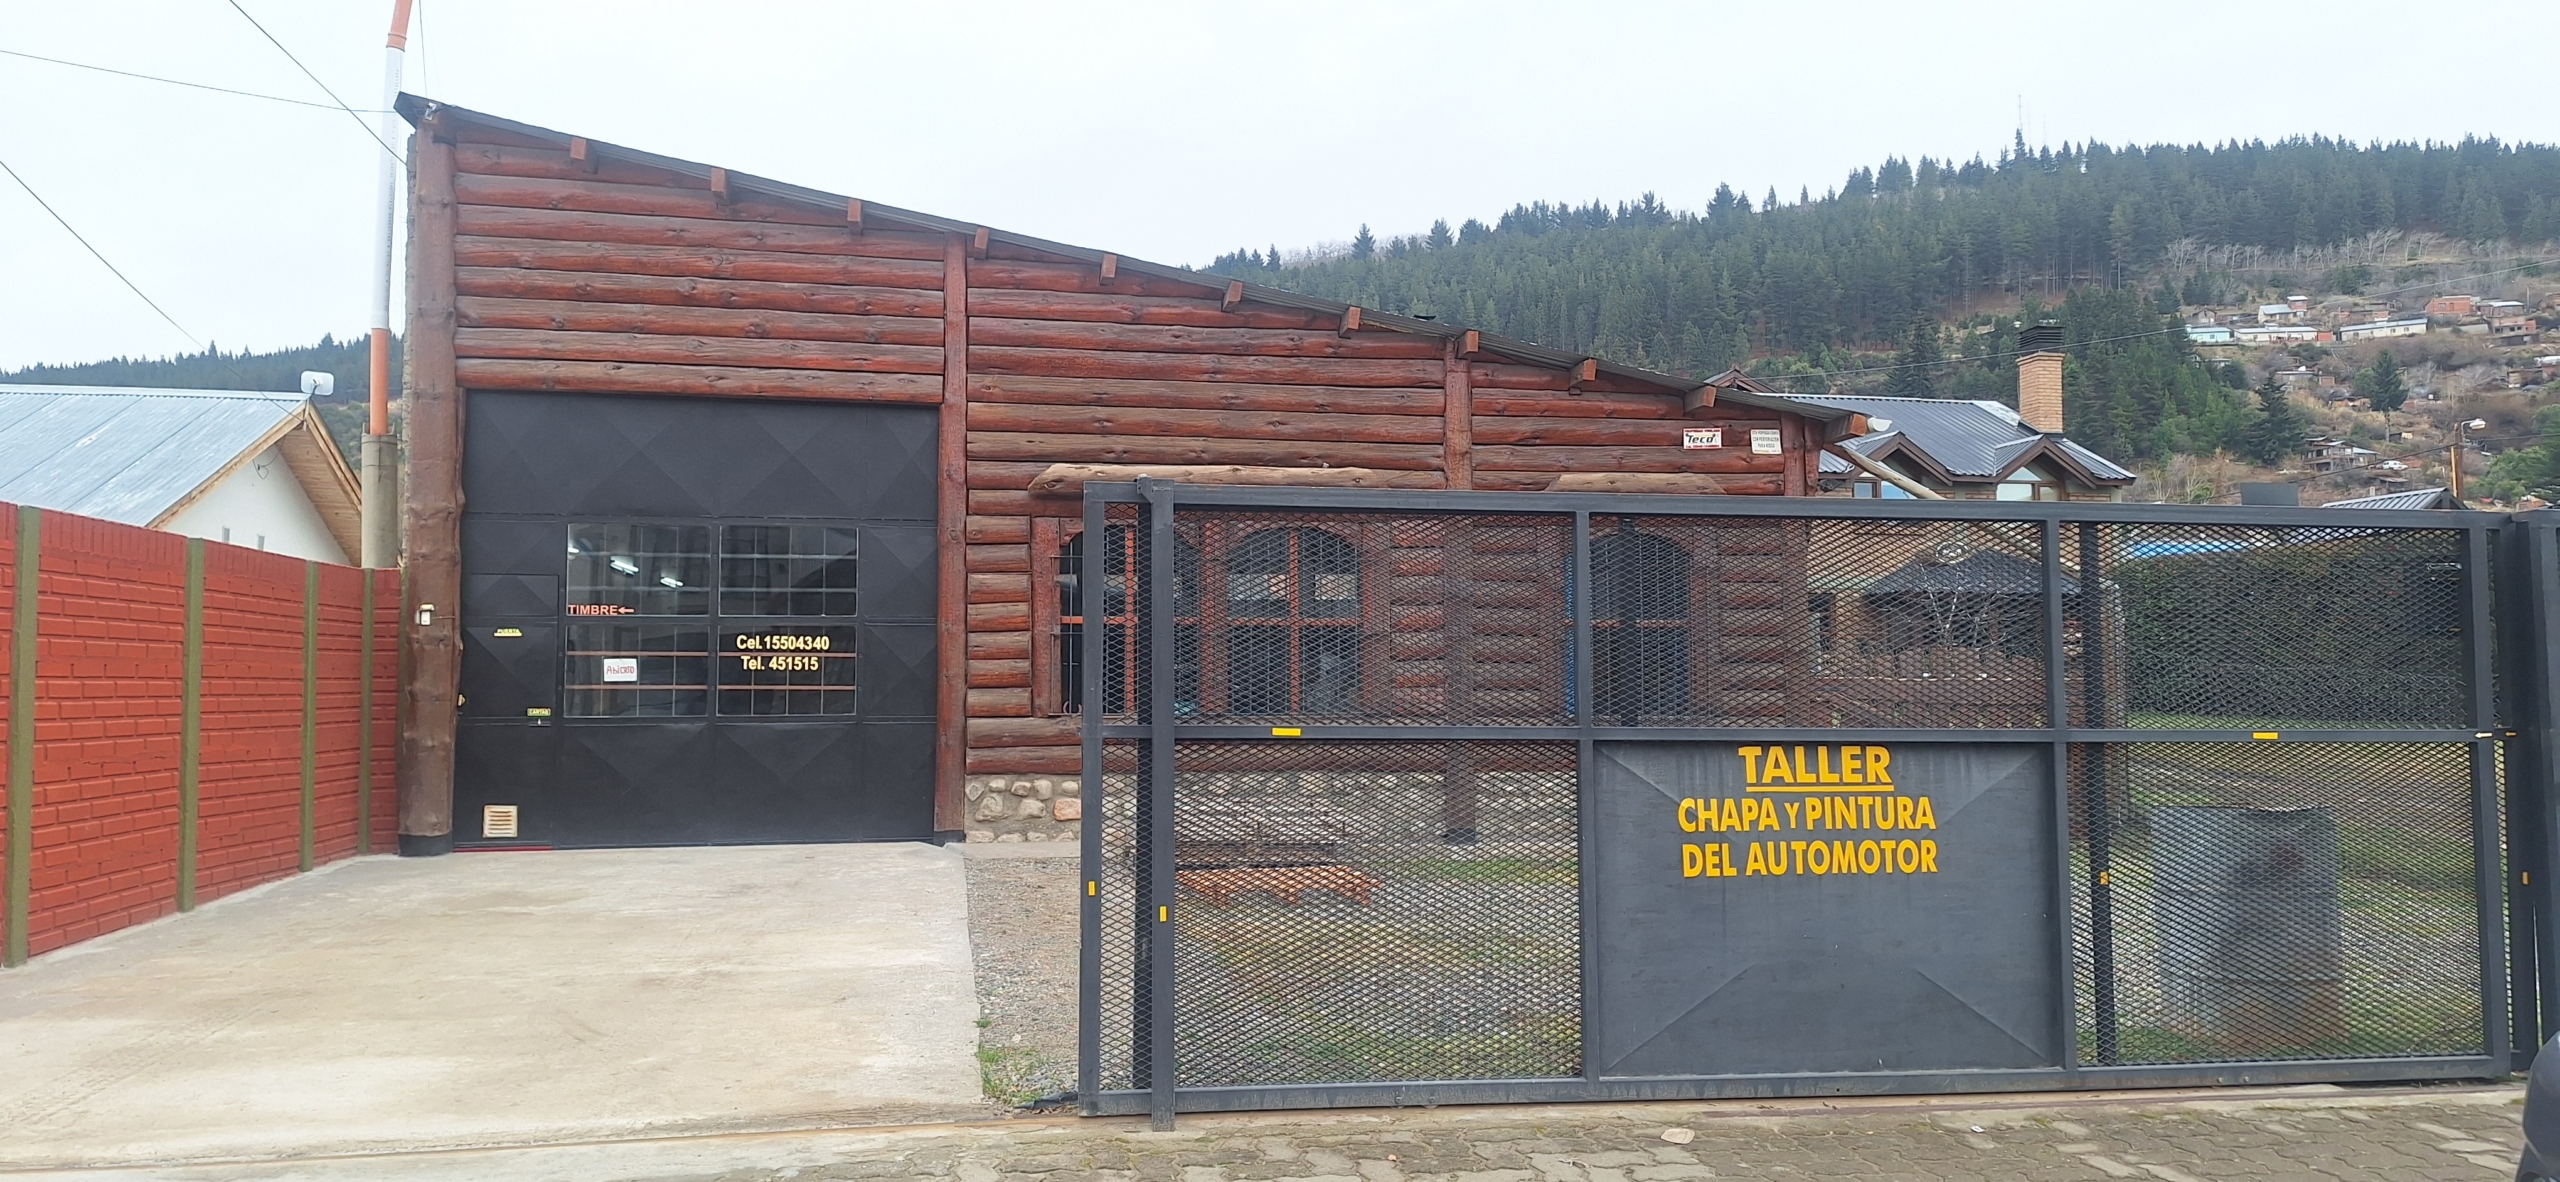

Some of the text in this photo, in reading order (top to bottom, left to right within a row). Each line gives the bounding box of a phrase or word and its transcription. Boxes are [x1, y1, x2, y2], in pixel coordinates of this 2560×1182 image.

[568, 604, 619, 616] TIMBRE
[740, 655, 819, 671] Tel. 451515
[1738, 746, 1892, 783] TALLER
[1678, 797, 1936, 832] CHAPA Y PINTURA
[1682, 839, 1939, 878] DEL AUTOMOTOR
